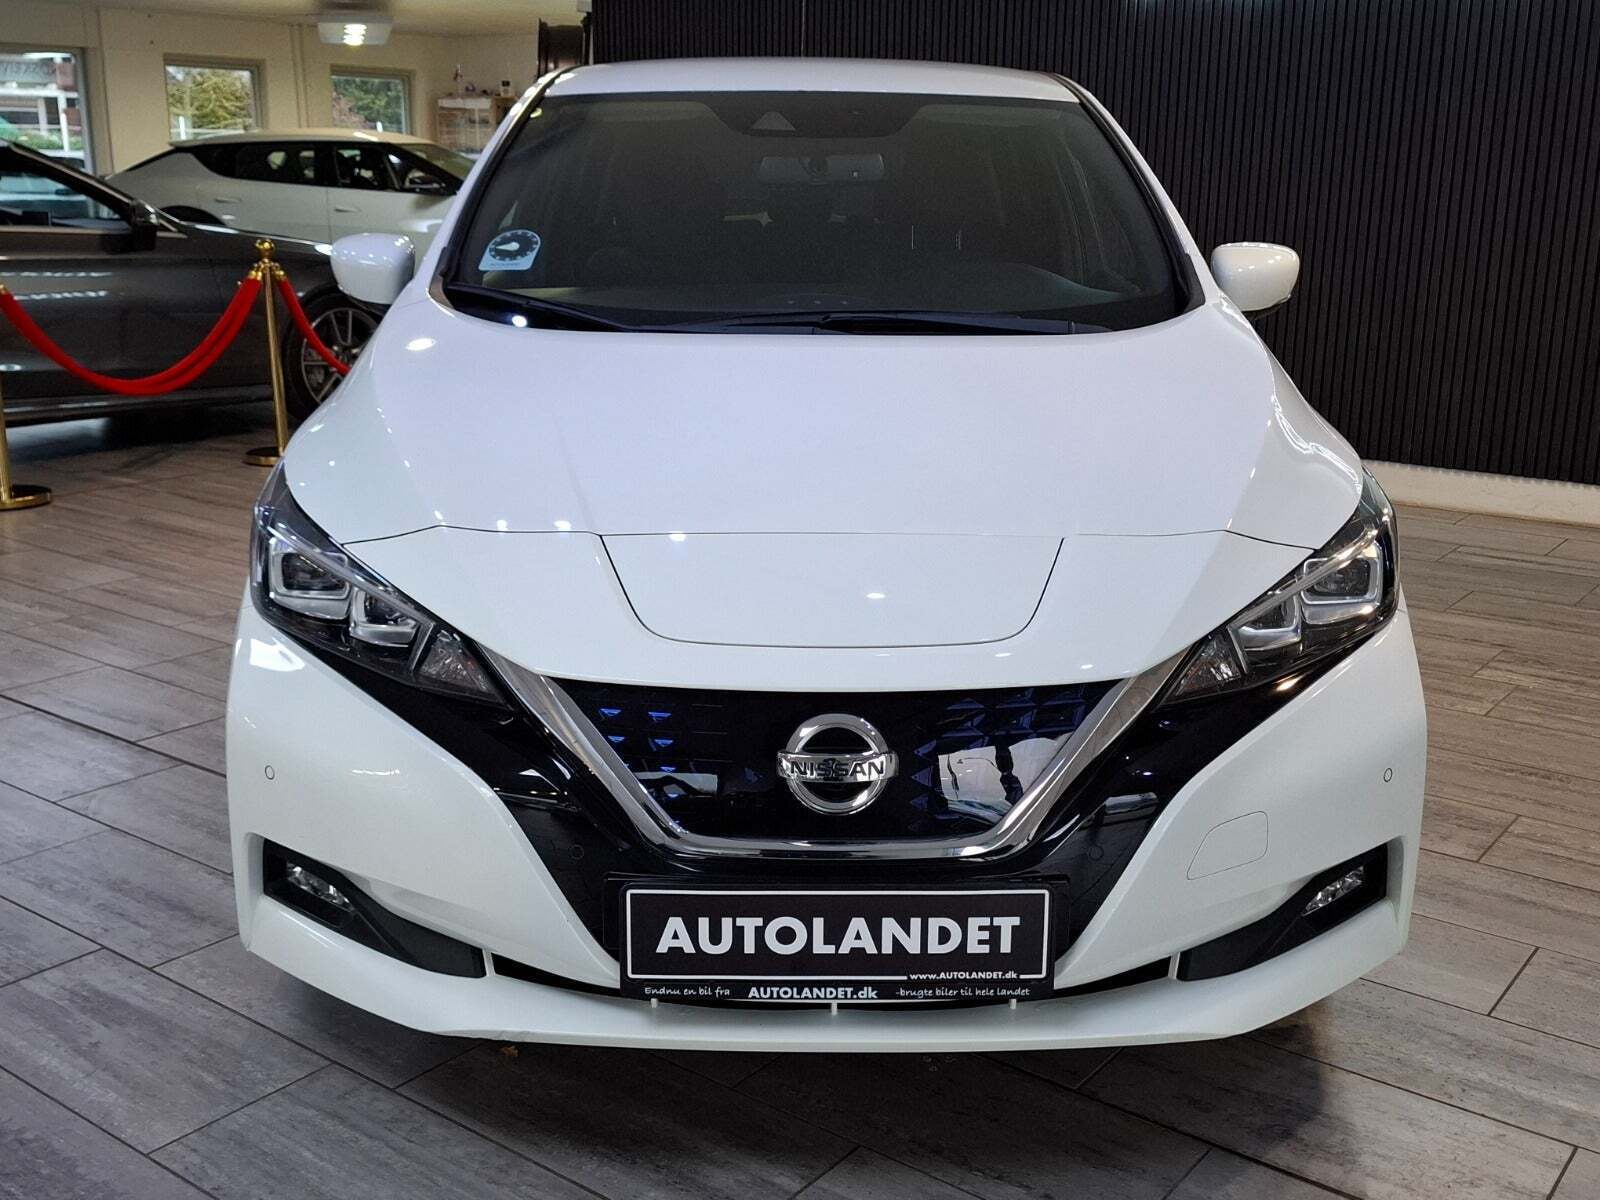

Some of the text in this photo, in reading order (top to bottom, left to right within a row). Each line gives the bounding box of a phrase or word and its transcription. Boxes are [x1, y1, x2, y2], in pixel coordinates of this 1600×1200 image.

[790, 760, 884, 777] NISSAN
[655, 916, 1021, 955] AUTOLANDET
[909, 970, 1019, 981] www.AUTOLANDET.dk
[644, 986, 731, 998] Endnu en bil fra
[748, 986, 879, 1000] AUTOLANDET.dk
[935, 986, 959, 997] biler
[960, 986, 973, 997] til
[975, 986, 994, 997] hele
[996, 986, 1031, 997] landet
